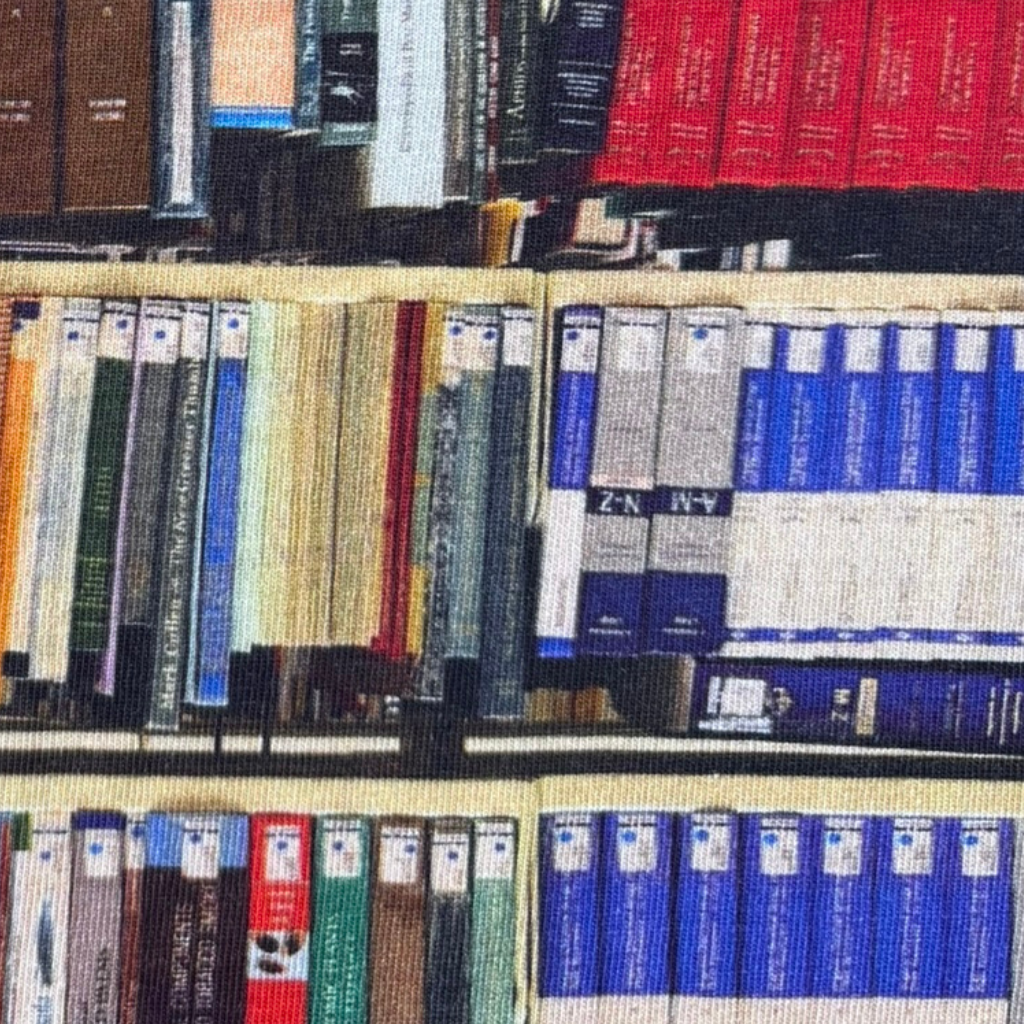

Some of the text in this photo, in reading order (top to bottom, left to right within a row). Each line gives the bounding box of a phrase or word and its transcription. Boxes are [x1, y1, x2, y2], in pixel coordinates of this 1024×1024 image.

[597, 490, 642, 513] N-Z
[669, 490, 718, 513] A-M
[160, 663, 178, 711] Mark
[197, 939, 217, 1009] TOBACCO
